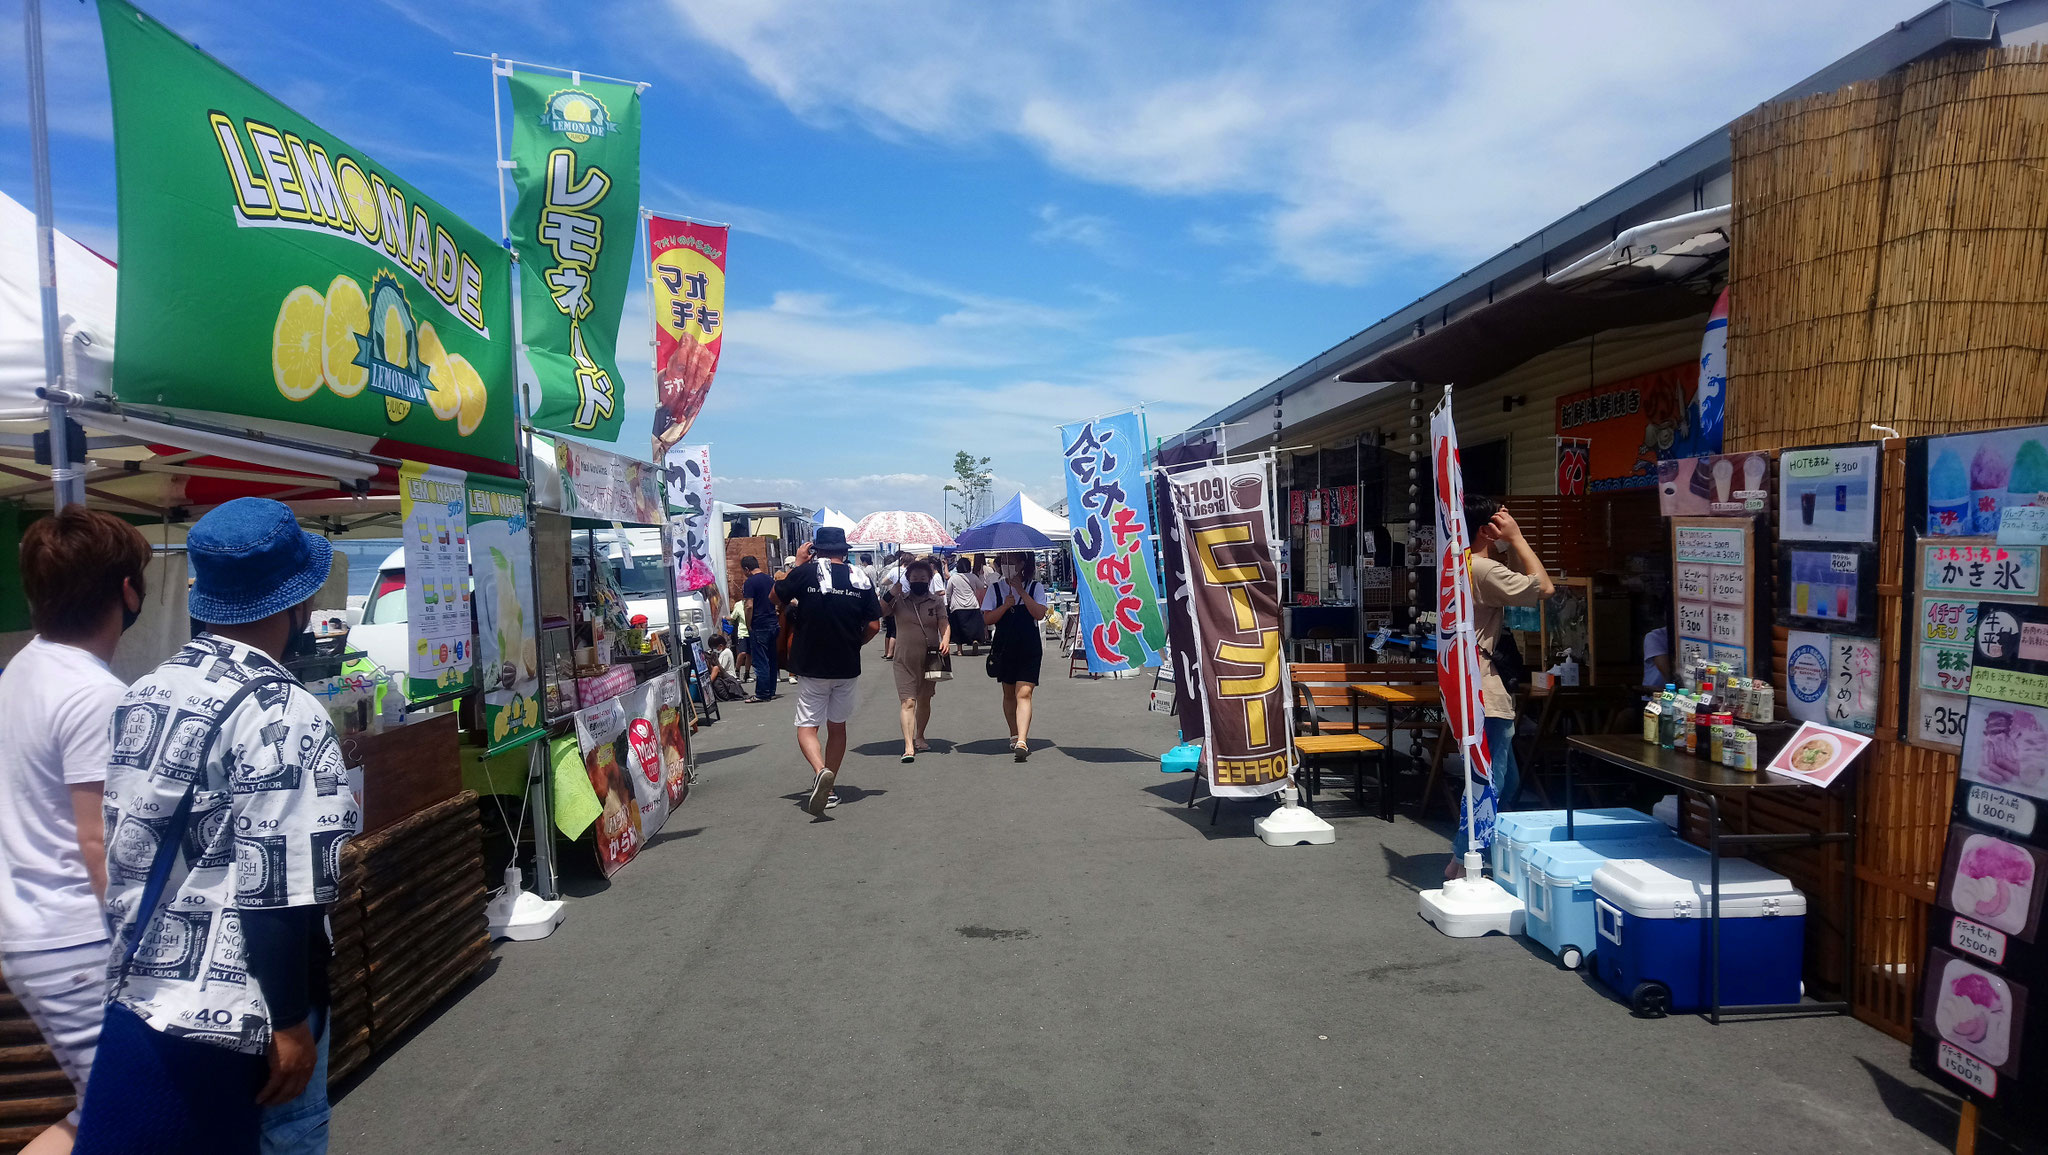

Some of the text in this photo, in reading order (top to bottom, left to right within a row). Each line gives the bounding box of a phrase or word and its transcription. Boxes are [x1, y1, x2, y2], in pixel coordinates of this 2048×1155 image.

[553, 120, 605, 135] LEMONADE
[209, 111, 483, 329] LEMONADE
[541, 149, 614, 430] レモネード
[371, 362, 424, 400] LEMONADE
[407, 479, 464, 504] LEMONADE
[468, 490, 524, 518] LEMONADE
[1941, 561, 2026, 590] かき氷
[1927, 602, 1965, 624] イチゴ
[1927, 623, 1959, 640] レモン
[1936, 650, 1970, 672] 抹茶
[1836, 645, 1853, 719] そうめん
[1855, 646, 1874, 711] 冷やし
[258, 819, 279, 829] 40
[317, 814, 340, 824] 40
[343, 810, 358, 825] 40
[1977, 803, 2016, 824] 1800円
[182, 895, 206, 905] 40
[1959, 934, 1998, 958] 2500円
[194, 1008, 233, 1026] 40
[1945, 1057, 1983, 1086] 1500円
